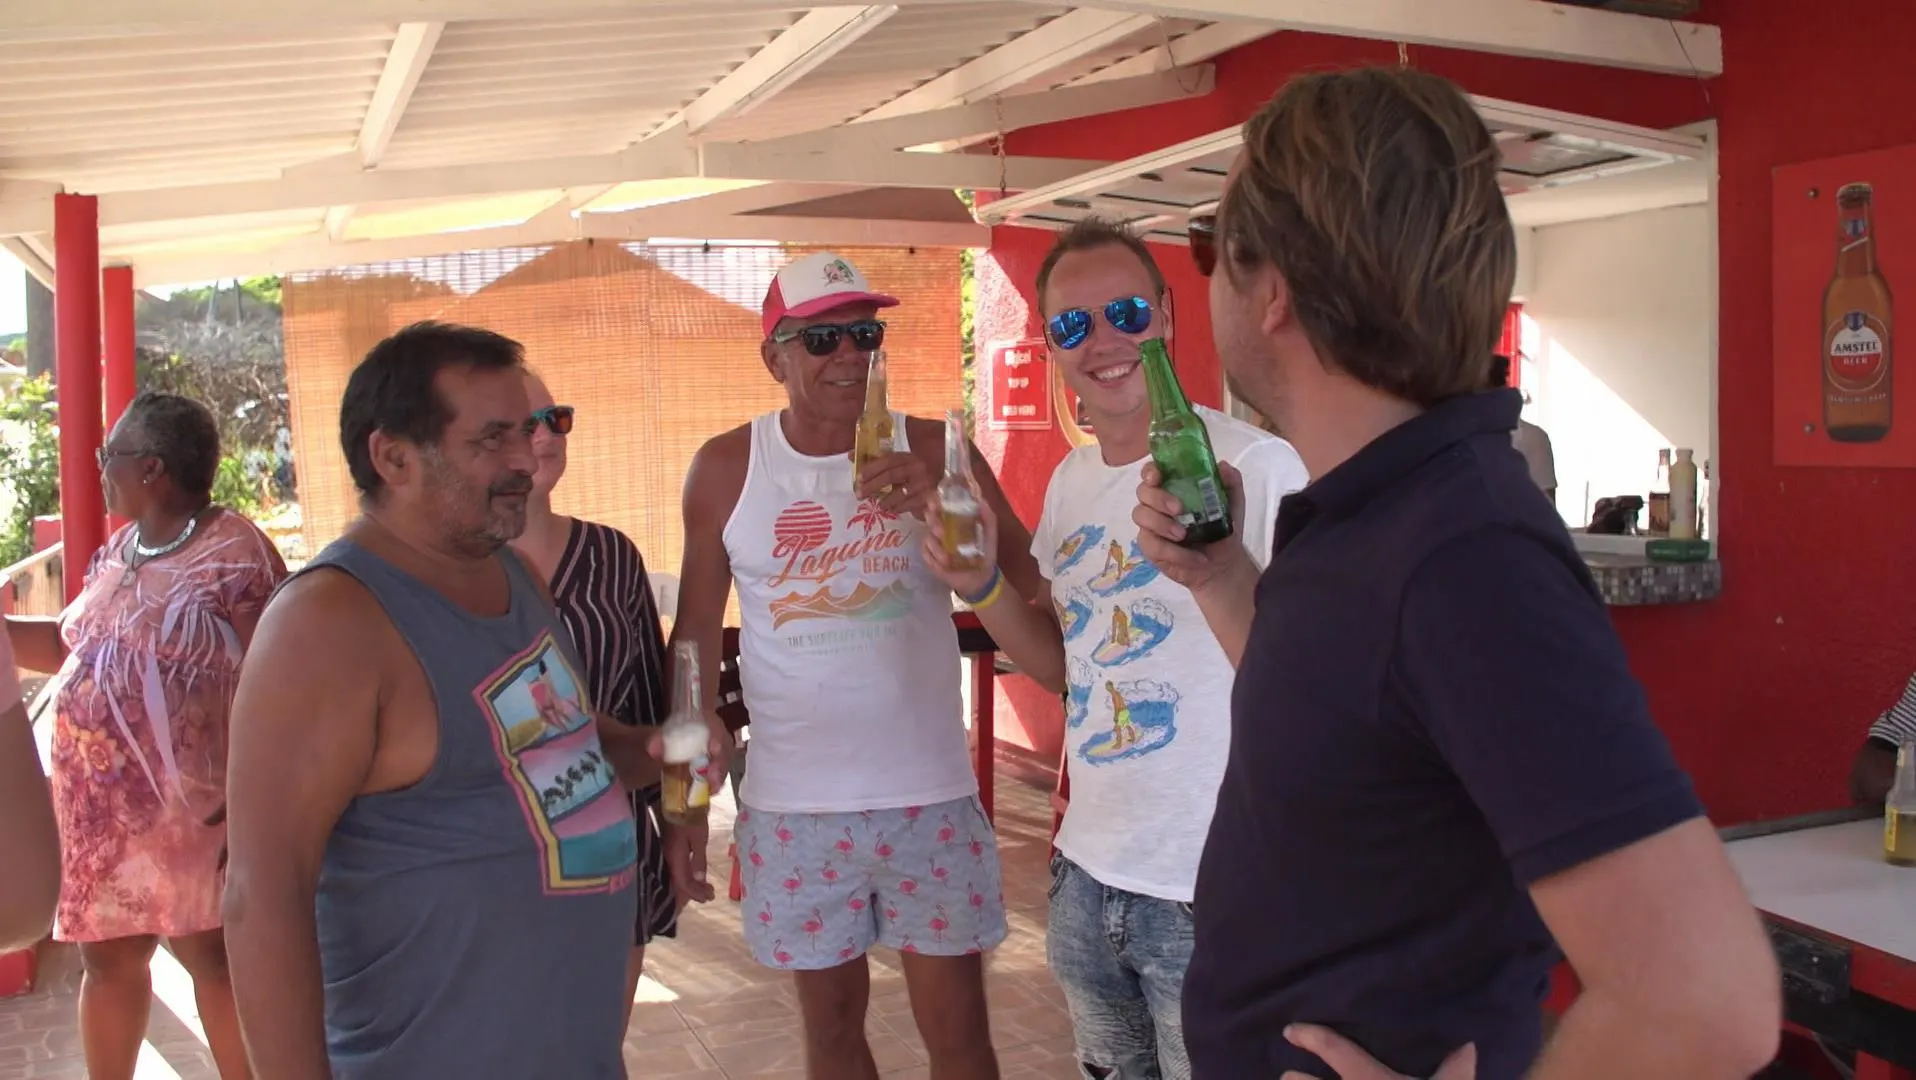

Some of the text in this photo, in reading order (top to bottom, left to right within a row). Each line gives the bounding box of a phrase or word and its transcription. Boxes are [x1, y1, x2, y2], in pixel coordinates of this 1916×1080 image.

[1834, 341, 1877, 352] AMSTEL
[1843, 357, 1868, 365] BEER
[768, 529, 912, 588] Laguna
[863, 555, 910, 574] BEACH
[787, 634, 803, 648] THE
